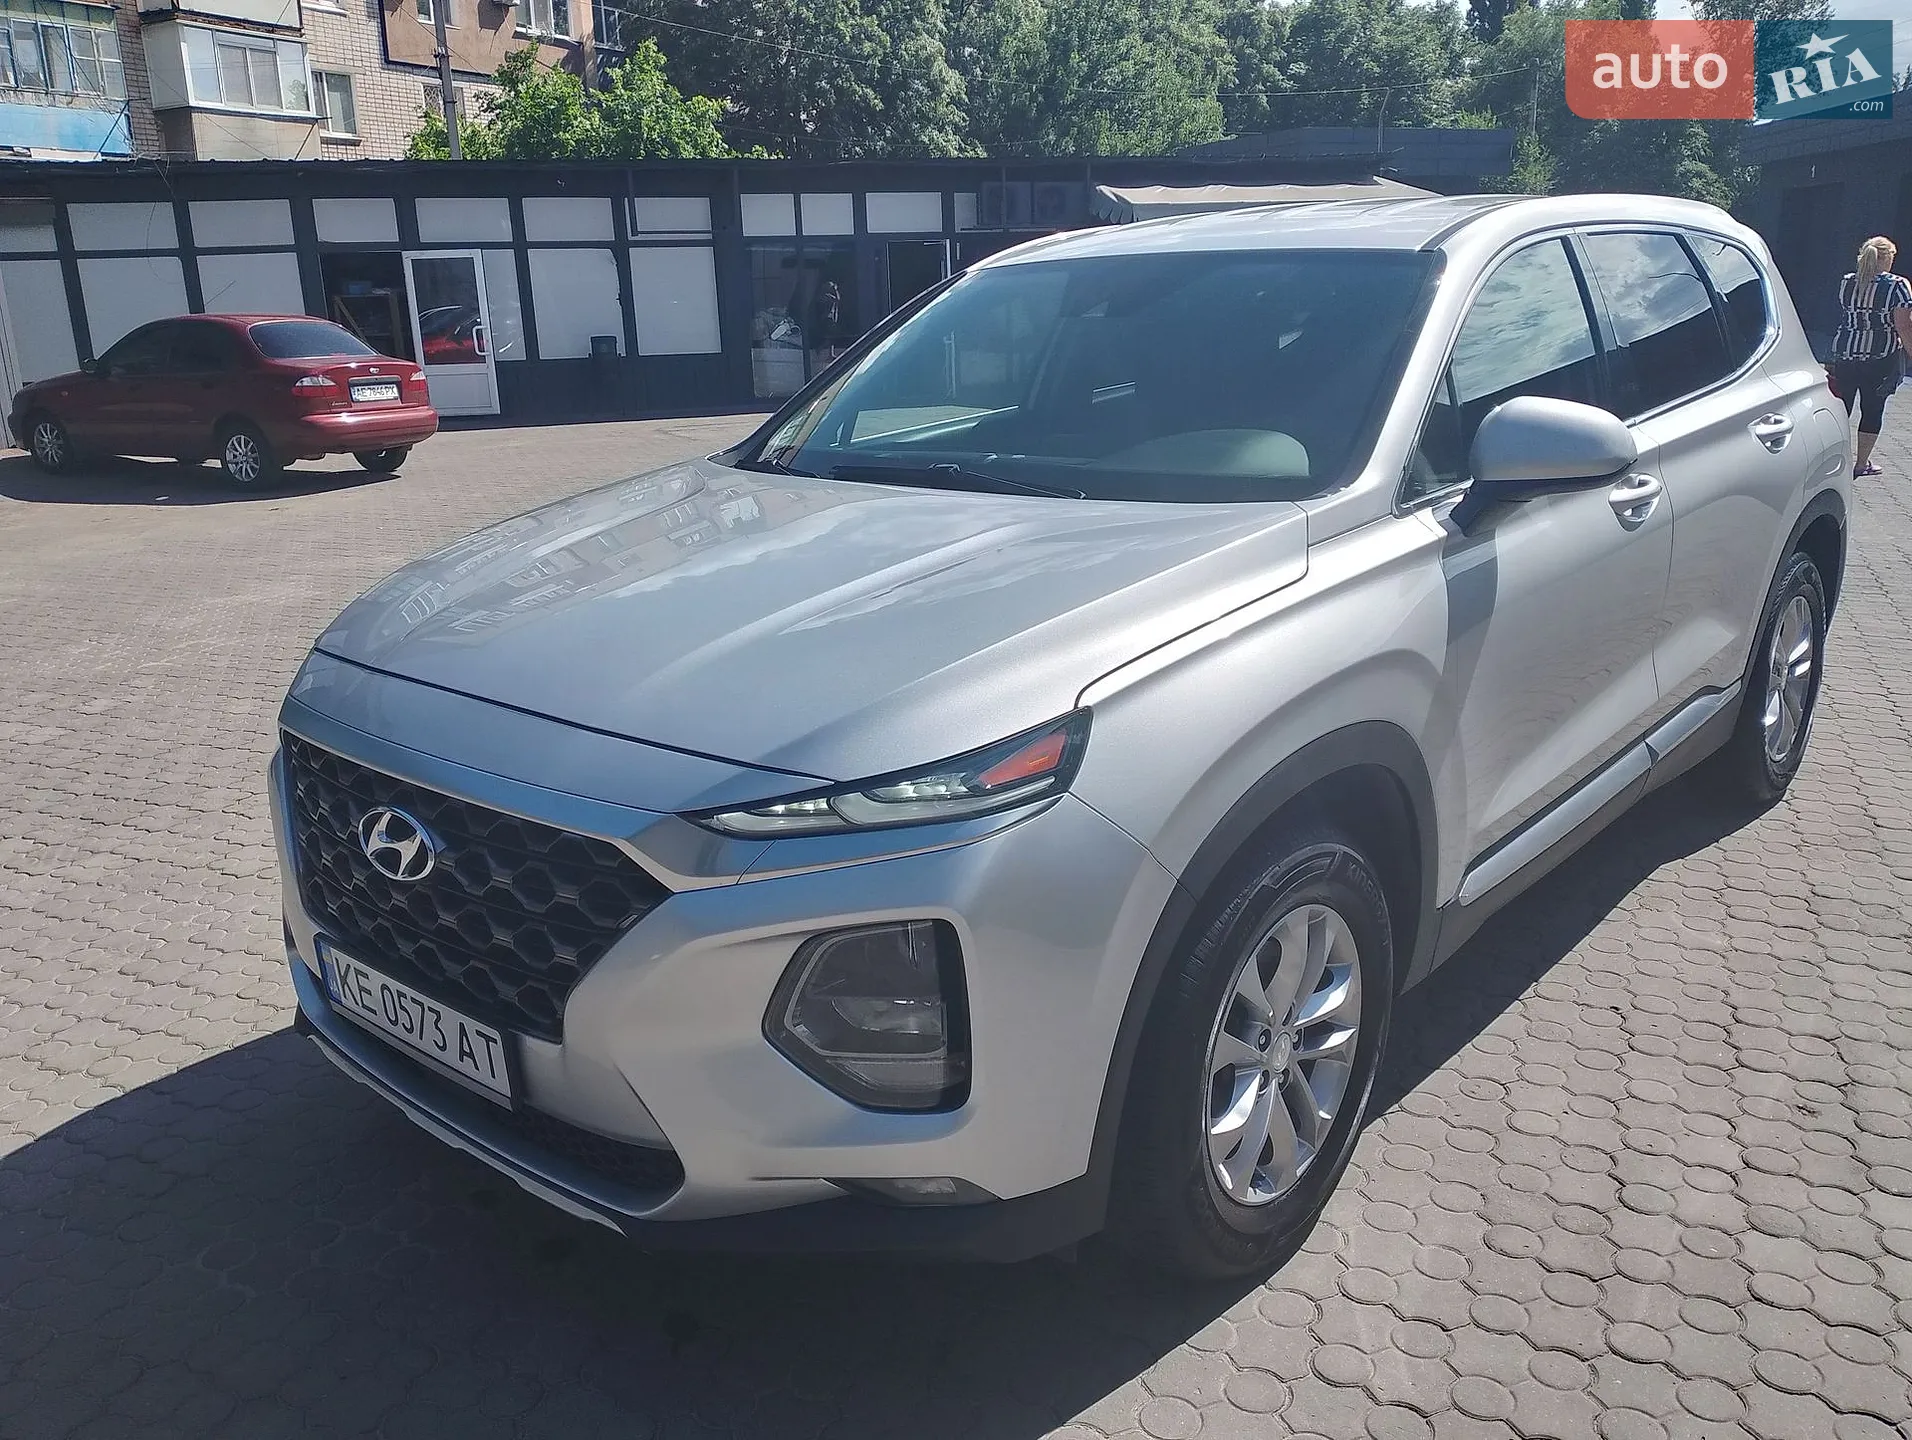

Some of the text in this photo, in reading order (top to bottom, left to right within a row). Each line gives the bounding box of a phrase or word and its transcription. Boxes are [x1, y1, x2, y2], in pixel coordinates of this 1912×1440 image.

[335, 956, 498, 1080] KE 0573 AT
